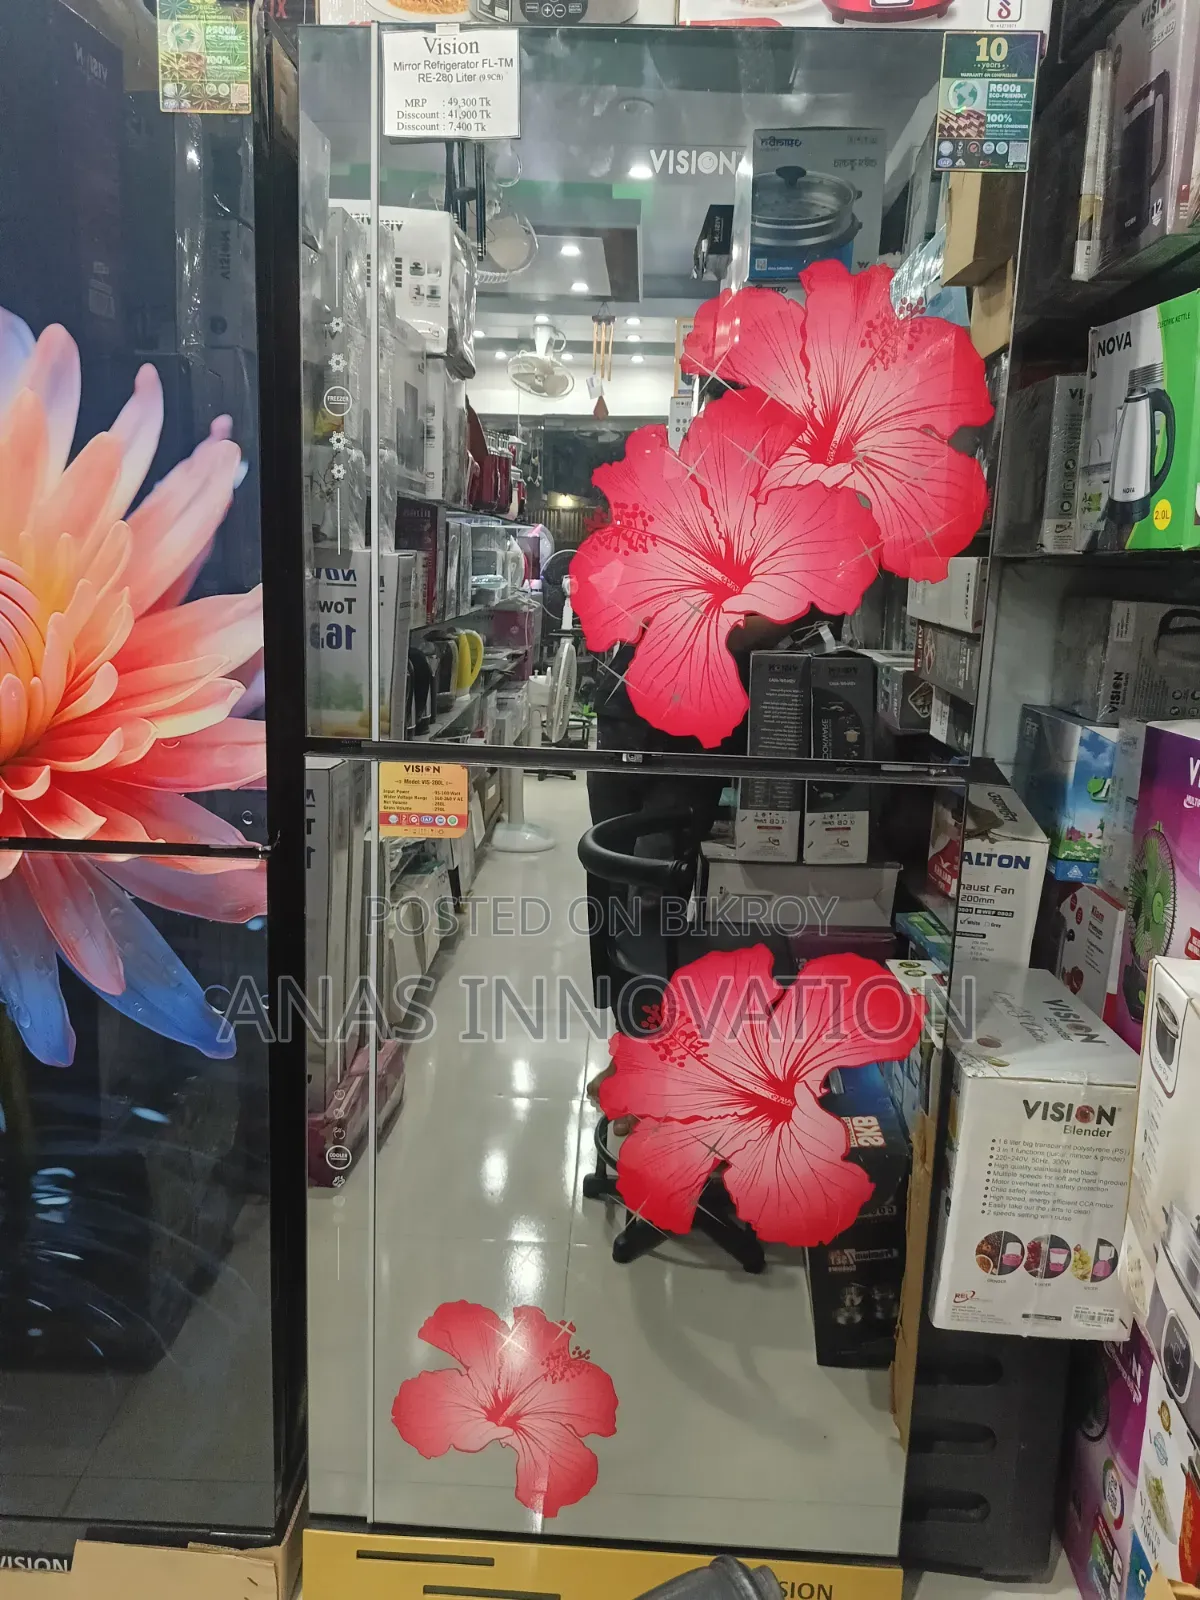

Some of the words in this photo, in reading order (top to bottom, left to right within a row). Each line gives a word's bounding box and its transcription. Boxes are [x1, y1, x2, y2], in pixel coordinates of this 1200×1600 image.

[422, 36, 480, 55] Vision
[975, 37, 1009, 62] 10
[393, 61, 421, 71] Mirror
[423, 59, 479, 72] Refrigerator
[481, 57, 514, 68] FL-TM
[981, 62, 1001, 70] years
[418, 72, 453, 83] RE-280
[456, 73, 477, 83] Liter
[989, 83, 1021, 92] R600a
[404, 98, 427, 108] MRP
[447, 97, 477, 109] 49,300
[479, 97, 491, 107] Tk
[396, 110, 439, 119] Disscount
[447, 109, 478, 120] 41,900
[479, 110, 492, 119] Tk
[986, 113, 1013, 123] 100%
[396, 122, 439, 131] Disscount
[448, 121, 472, 132] 7,400
[474, 122, 486, 132] Tk
[649, 149, 737, 175] VISION
[1175, 311, 1191, 324] KETTLE
[1097, 331, 1133, 358] NOVA
[1154, 508, 1171, 521] 2.0L
[1107, 671, 1125, 714] VISION
[403, 764, 441, 773] VISION
[961, 851, 1031, 870] ALTON
[959, 881, 990, 893] haust
[994, 884, 1015, 895] Fan
[960, 894, 995, 905] 200mm
[1042, 999, 1107, 1044] VISION
[1022, 1099, 1117, 1127] VISION
[1063, 1124, 1113, 1138] Blender
[1022, 1140, 1033, 1148] big
[1073, 1144, 1111, 1153] polystyrene
[1015, 1148, 1045, 1156] functions
[1069, 1152, 1092, 1160] mincer
[1099, 1155, 1126, 1164] grinder)
[994, 1162, 1009, 1170] High
[1010, 1163, 1032, 1172] quality
[1033, 1165, 1062, 1173] stainless
[992, 1170, 1018, 1178] Multiple
[1019, 1172, 1043, 1181] speeds
[1054, 1174, 1067, 1182] soft
[1081, 1176, 1097, 1184] hard
[991, 1178, 1010, 1186] Motor
[1011, 1180, 1040, 1188] overheat
[1041, 1181, 1055, 1189] with
[1055, 1183, 1075, 1192] safety
[1076, 1185, 1109, 1194] protection
[1008, 1187, 1028, 1196] safety
[989, 1193, 1005, 1201] High
[1028, 1197, 1051, 1206] energy
[1052, 1198, 1078, 1207] efficient
[1078, 1200, 1095, 1208] CCA
[988, 1201, 1008, 1210] Easily
[1073, 1207, 1091, 1215] clean
[992, 1210, 1016, 1218] speeds
[1017, 1211, 1039, 1220] setting
[1054, 1214, 1072, 1222] pulse
[779, 1581, 833, 1600] SION
